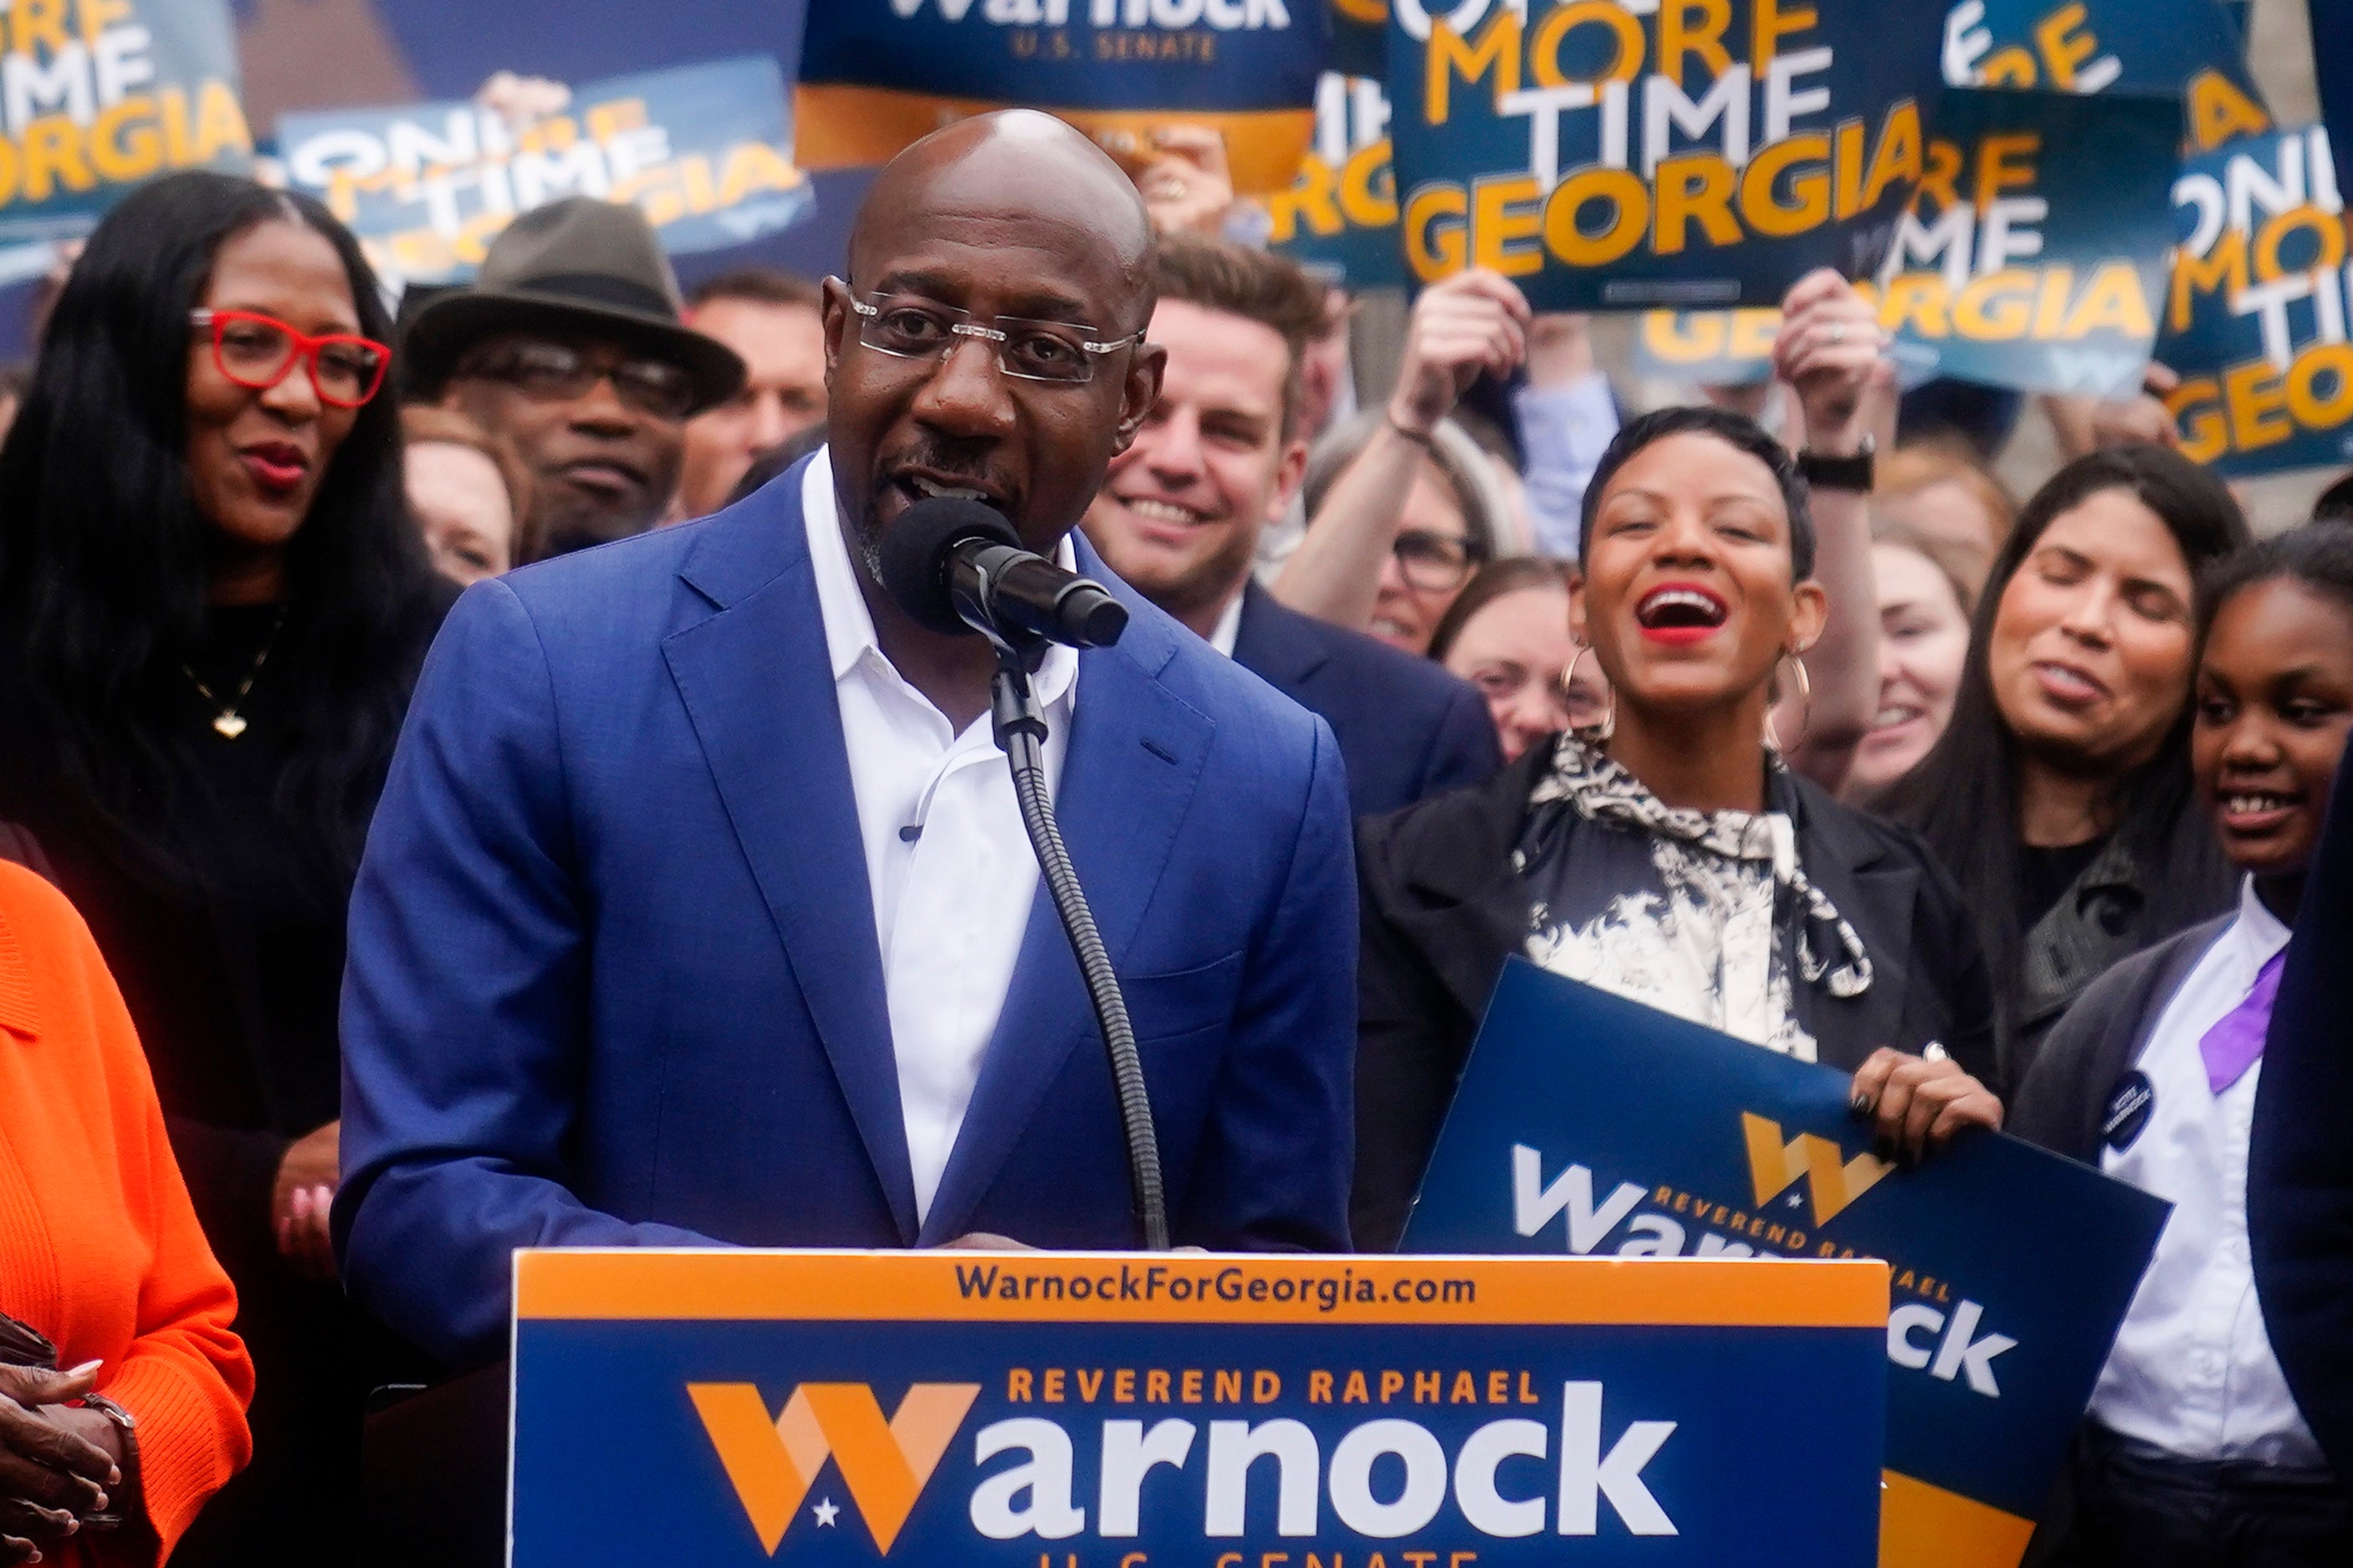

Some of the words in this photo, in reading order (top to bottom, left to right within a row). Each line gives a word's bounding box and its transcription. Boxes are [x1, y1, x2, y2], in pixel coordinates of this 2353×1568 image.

[1096, 31, 1216, 63] SENATE
[1424, 0, 1818, 125] MORE
[1500, 46, 1832, 195] TIME
[1402, 97, 1924, 284] GEORGIA
[2231, 266, 2353, 375] TI
[955, 1264, 1477, 1311] WarnockForGeorgia.com
[1512, 1142, 2018, 1397] Wack
[1655, 1185, 1808, 1250] REVEREND
[1818, 1240, 1951, 1302] RAAEL
[1008, 1368, 1282, 1403] REVEREND
[1310, 1371, 1540, 1405] RAPHAEL
[685, 1381, 1680, 1558] Warnock
